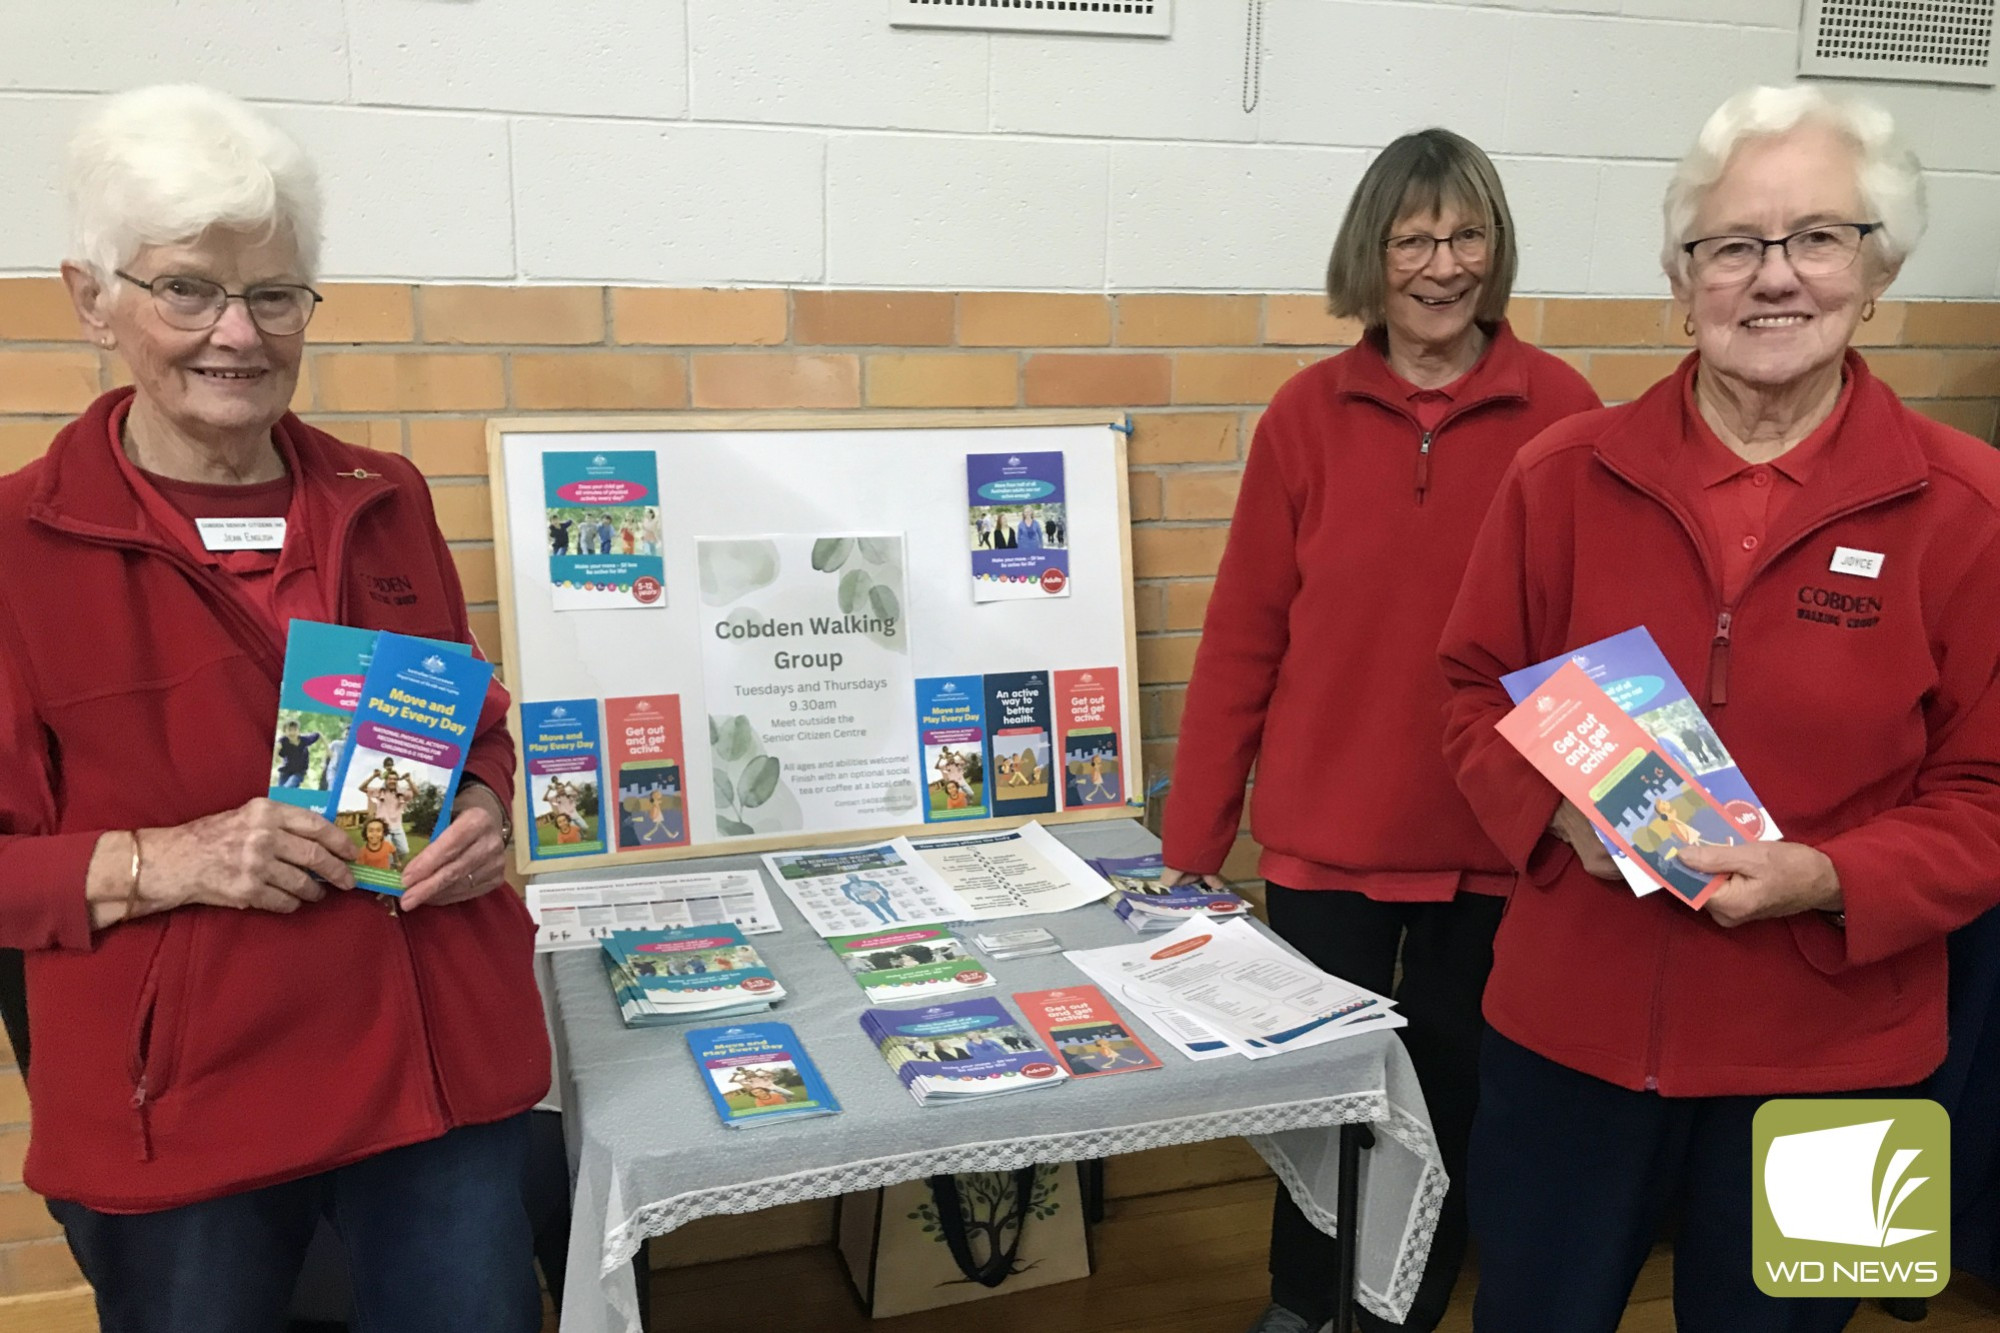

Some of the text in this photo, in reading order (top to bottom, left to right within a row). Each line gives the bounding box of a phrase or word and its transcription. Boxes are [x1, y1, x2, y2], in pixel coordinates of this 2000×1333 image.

[1043, 576, 1062, 584] Adults
[1798, 586, 1882, 614] COBDEN
[715, 614, 896, 640] Cobden Walking
[774, 651, 843, 671] Group
[734, 678, 888, 697] Tuesdays and Thursdays
[996, 688, 1039, 699] An active
[389, 687, 456, 716] Move and
[789, 698, 837, 712] 9.30am
[1001, 696, 1033, 707] way to
[1071, 695, 1104, 706] Get out
[955, 704, 970, 713] and
[1006, 706, 1035, 715] better
[1071, 703, 1105, 715] and get
[368, 697, 466, 736] Play Every Day
[771, 714, 855, 729] Meet outside the
[923, 713, 979, 724] Play Every Day
[1003, 715, 1036, 725] health.
[1074, 713, 1103, 722] active.
[539, 731, 583, 742] Move and
[625, 725, 664, 736] Get out
[762, 727, 867, 744] Senior Citizen Centre
[1553, 730, 1578, 754] Get
[1576, 712, 1598, 735] out
[529, 740, 594, 752] Play Every Day
[625, 734, 666, 746] and get
[1565, 722, 1610, 766] and get
[629, 744, 663, 754] active.
[1580, 741, 1619, 775] active.
[797, 763, 816, 772] ages
[818, 761, 834, 769] and
[835, 758, 868, 768] abilities
[791, 766, 910, 783] Finish with an optional social
[799, 787, 813, 795] tea
[815, 786, 824, 794] or
[826, 783, 853, 793] coffee
[854, 783, 864, 791] at
[871, 780, 892, 789] local
[1044, 1002, 1089, 1013] Get out
[1048, 1007, 1093, 1018] and get
[1055, 1014, 1094, 1022] active.
[746, 1039, 768, 1047] and
[728, 1046, 760, 1054] Every
